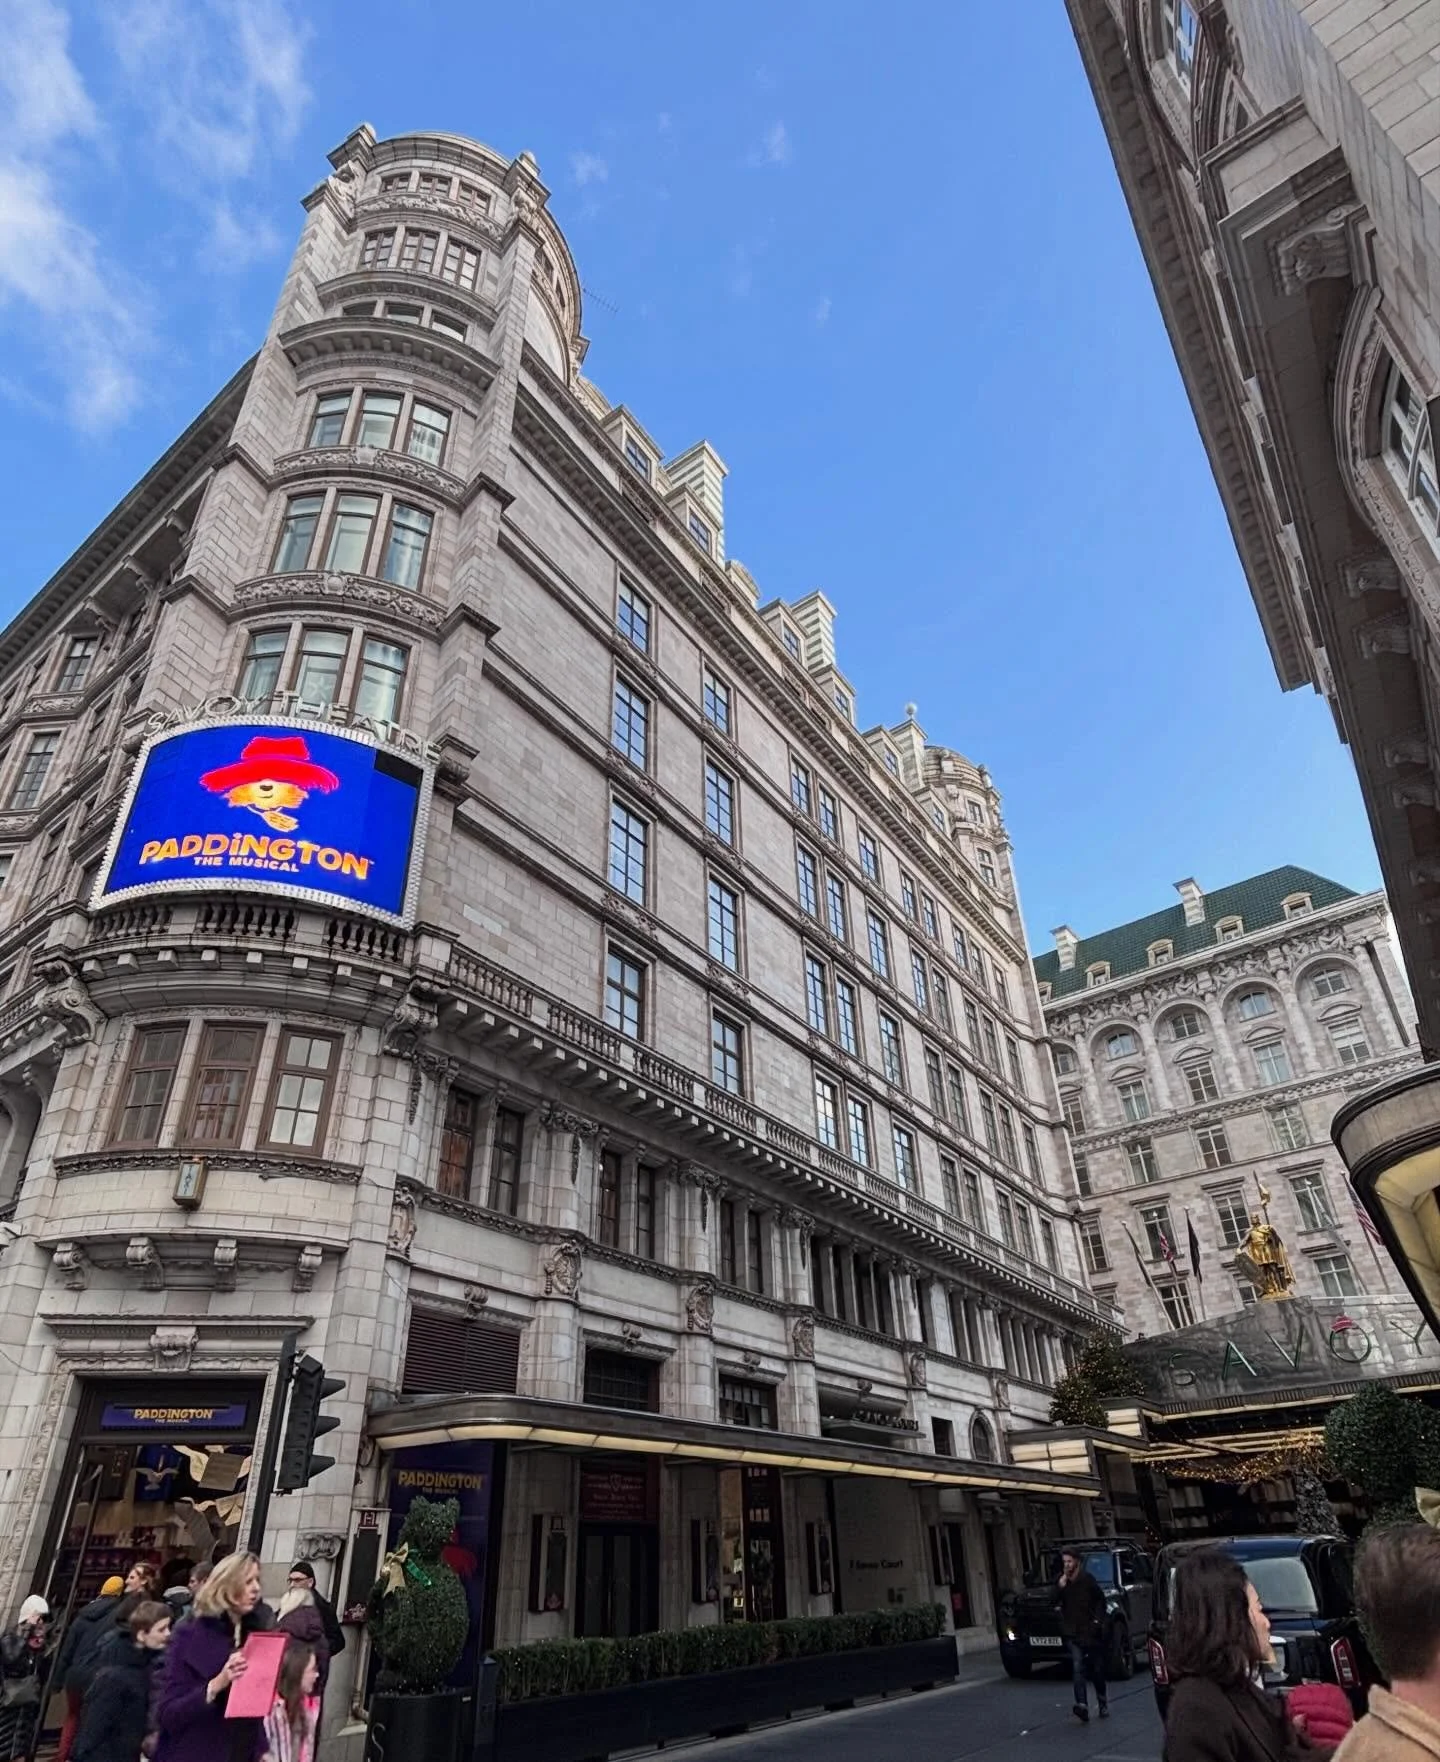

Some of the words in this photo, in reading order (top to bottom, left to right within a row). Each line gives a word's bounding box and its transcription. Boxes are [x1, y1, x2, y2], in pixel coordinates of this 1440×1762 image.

[146, 694, 268, 736] SAVOY
[274, 691, 441, 763] THEATRE
[139, 833, 369, 880] PADDINGTON
[194, 857, 222, 867] THE
[228, 857, 299, 873] MUSICAL
[1168, 1318, 1426, 1387] SAVOY
[134, 1408, 213, 1419] PADDINGTON
[398, 1471, 482, 1490] PADDINGTON
